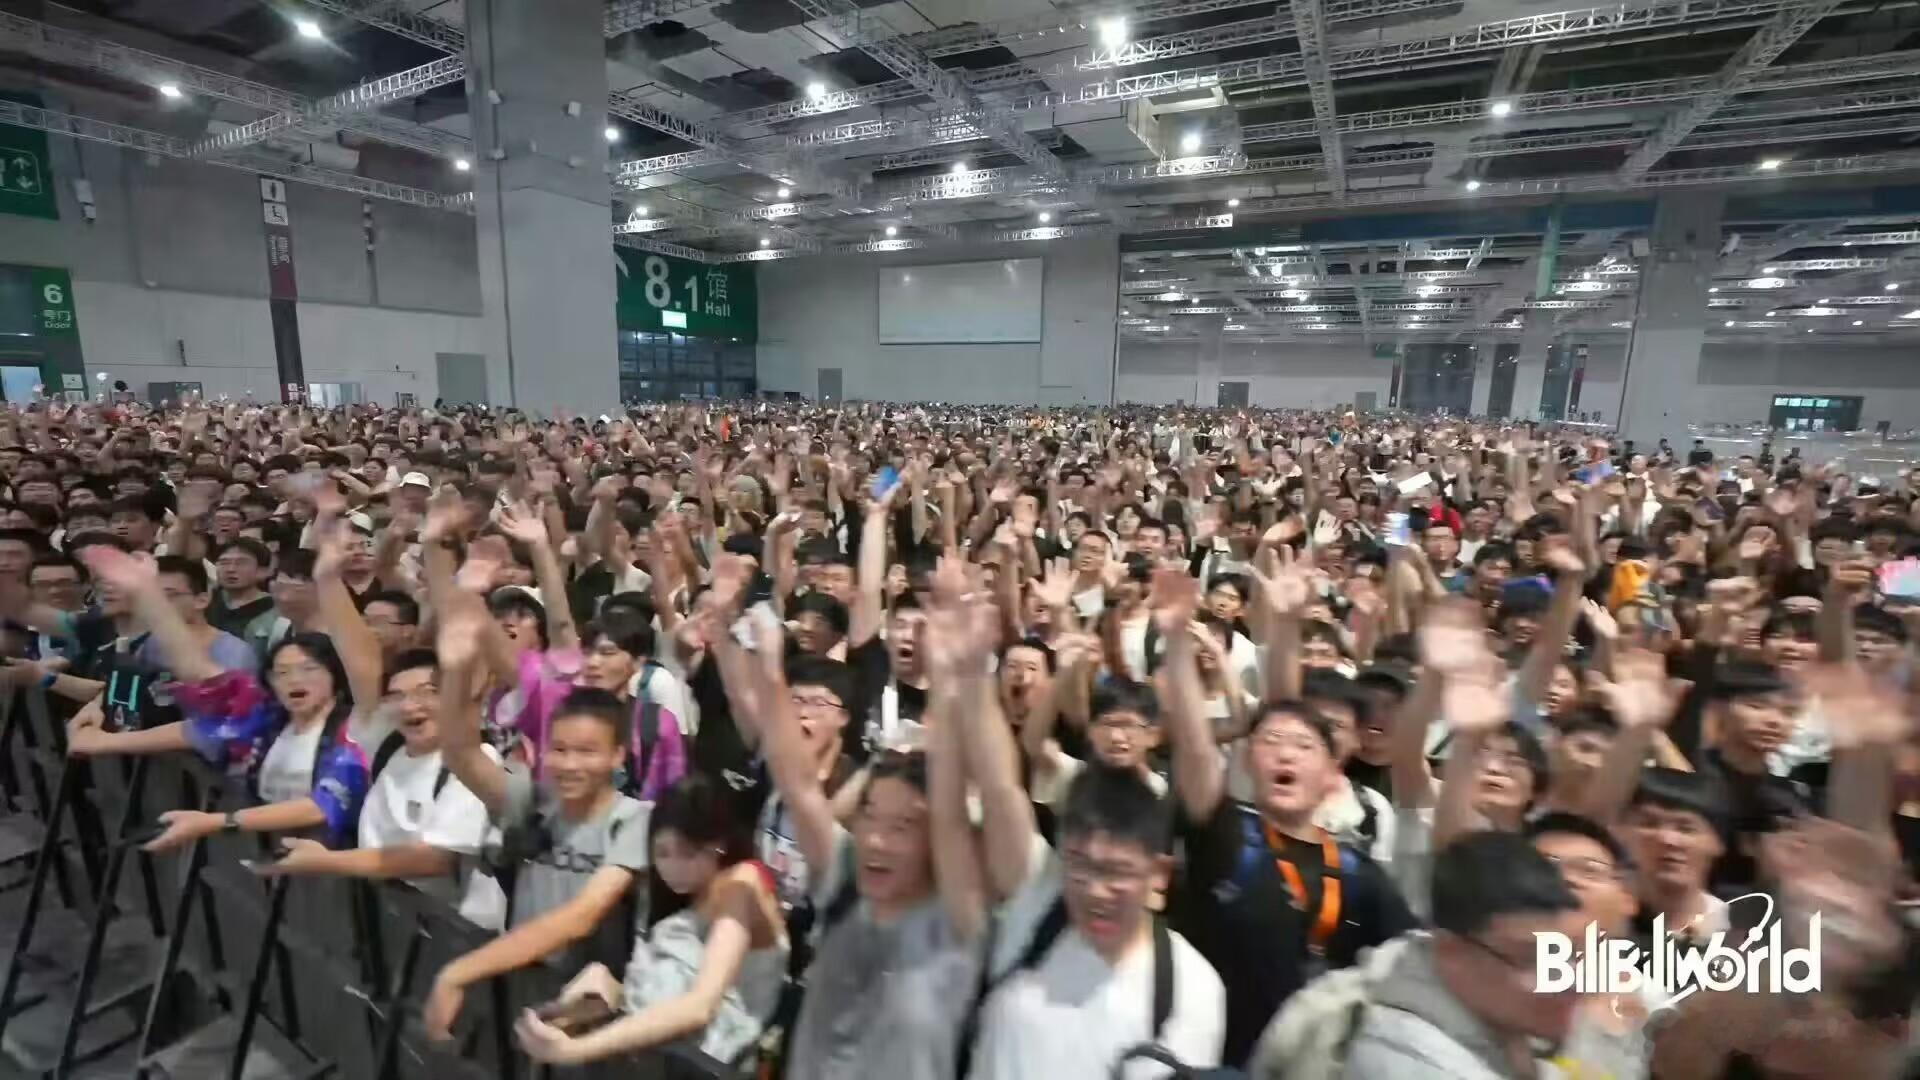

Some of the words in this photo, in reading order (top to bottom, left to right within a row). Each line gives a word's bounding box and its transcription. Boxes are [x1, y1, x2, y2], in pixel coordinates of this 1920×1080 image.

[44, 284, 63, 304] 6
[645, 255, 698, 312] 8.1
[706, 266, 728, 301] 馆
[705, 301, 730, 316] Hall
